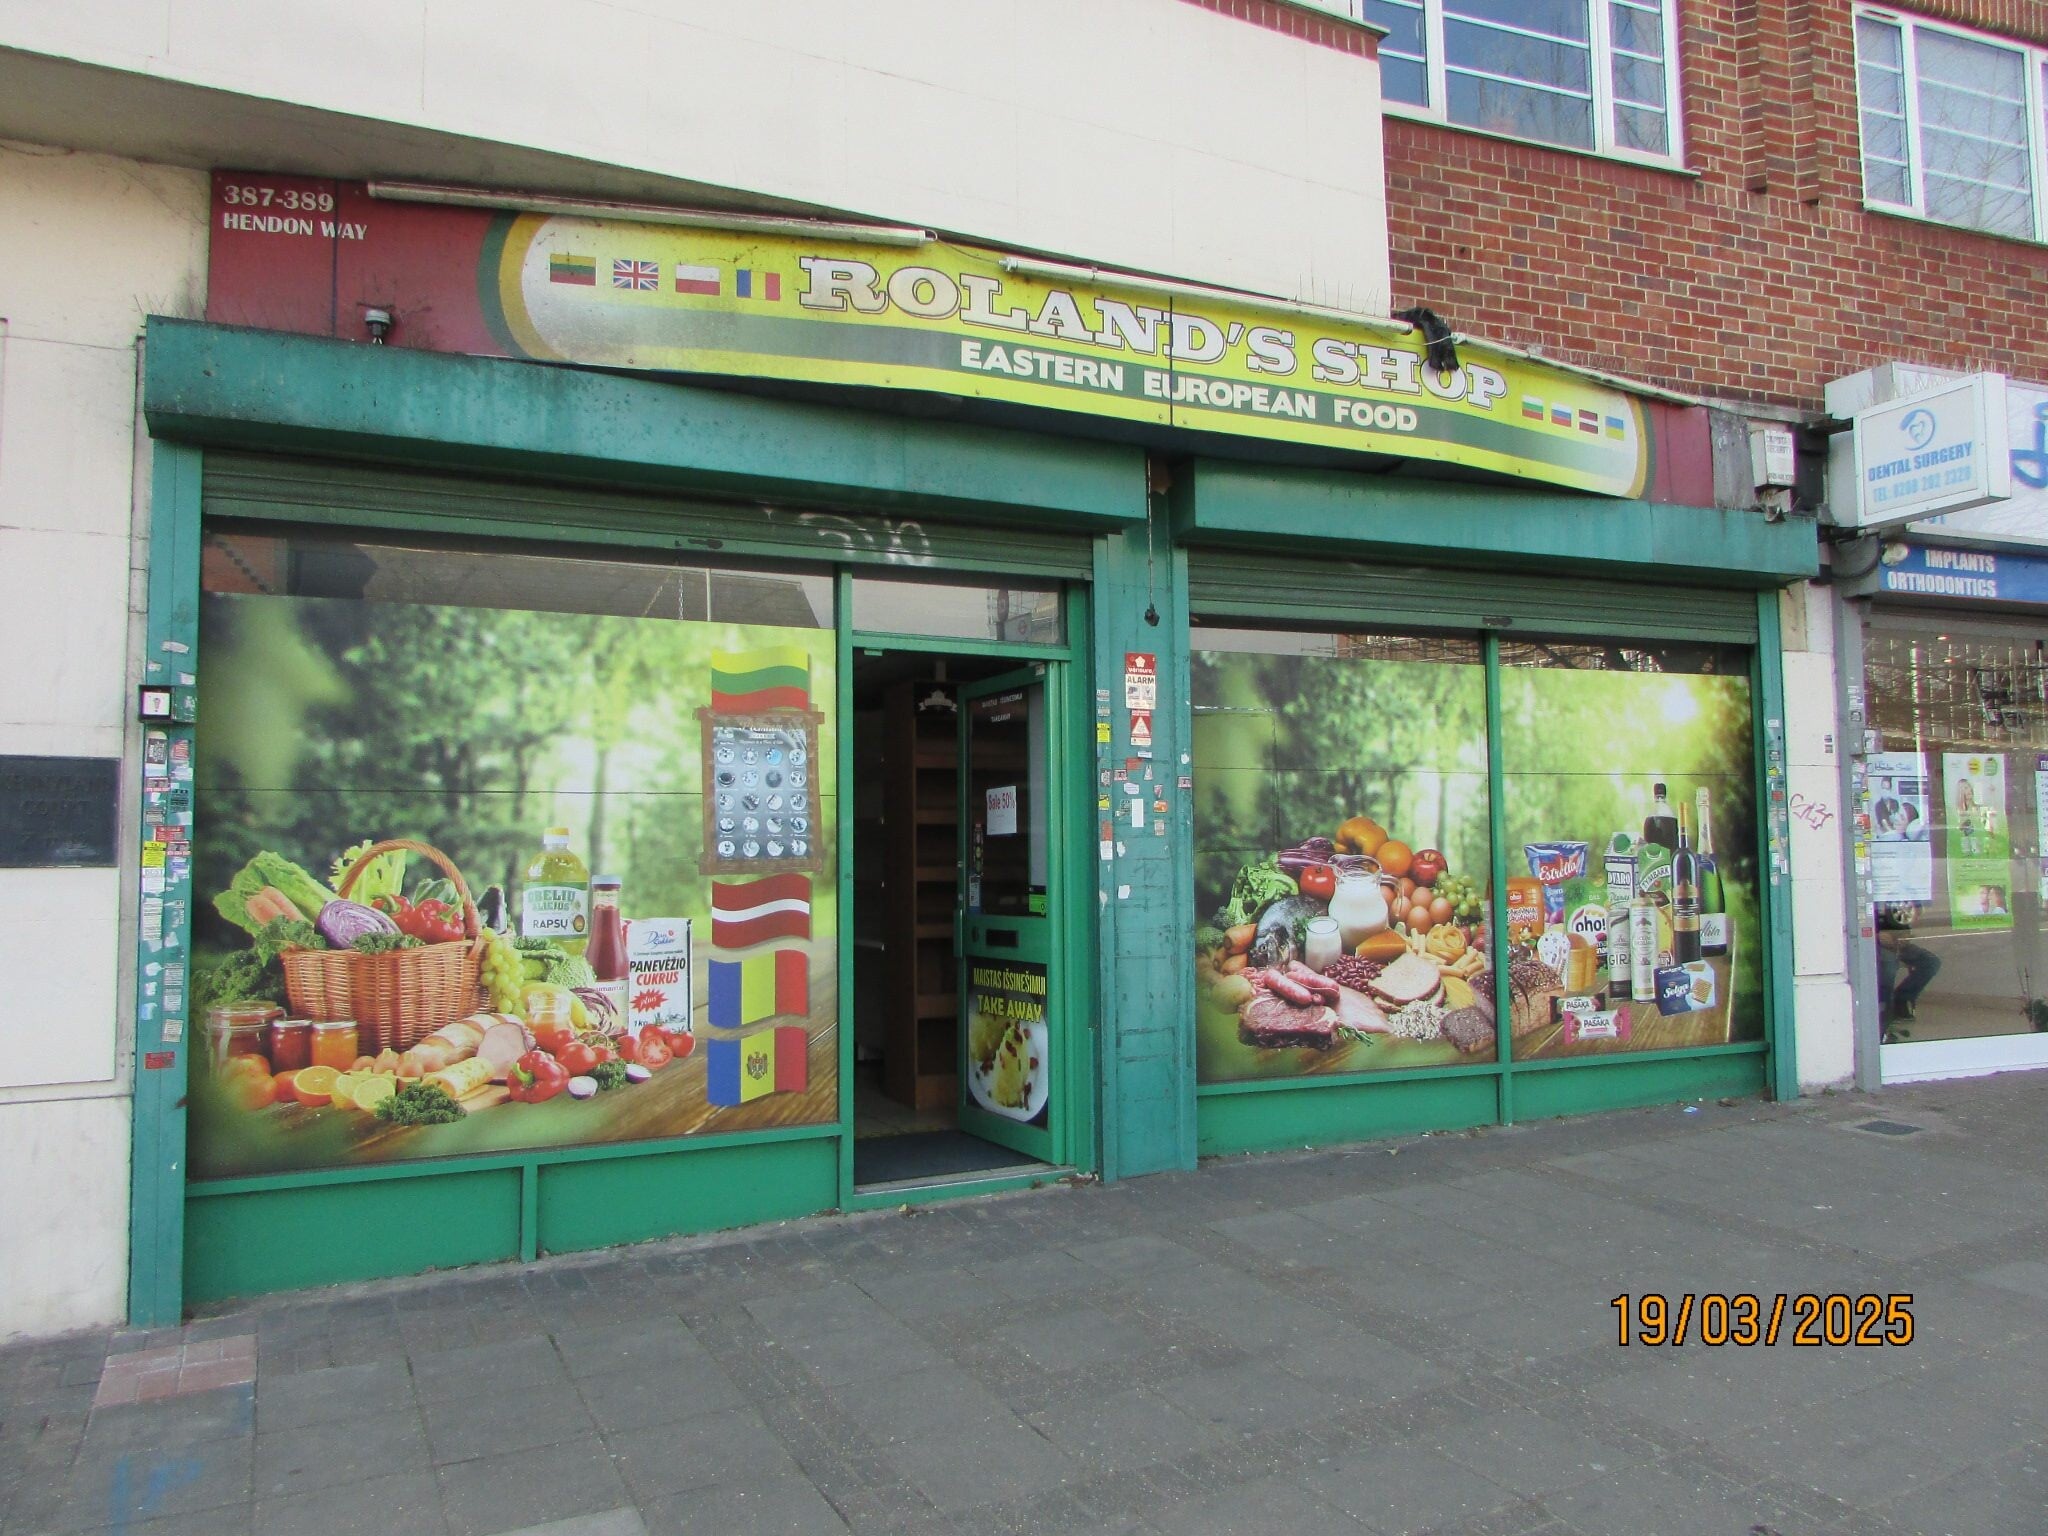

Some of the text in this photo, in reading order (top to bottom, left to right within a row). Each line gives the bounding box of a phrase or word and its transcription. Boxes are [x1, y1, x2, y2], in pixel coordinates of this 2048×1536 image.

[224, 185, 334, 212] 387-389
[223, 212, 368, 240] HENDON WAY
[800, 256, 1508, 410] ROLAND'S SHOP
[960, 340, 1417, 432] EASTERN EUROPEAN FOOD
[1868, 441, 1973, 482] DENTAL SURGERY
[1924, 549, 1996, 574] IMPLANTS
[1887, 571, 1998, 598] ORTHODONTICS
[1127, 675, 1155, 684] ALARM
[1539, 851, 1579, 881] Estrella
[533, 919, 569, 930] RAPSŲ
[1575, 916, 1606, 933] oho!
[629, 956, 687, 974] PANEVĖŽIO
[636, 971, 680, 987] CUKRUS
[977, 994, 1042, 1023] TAKE AWAY
